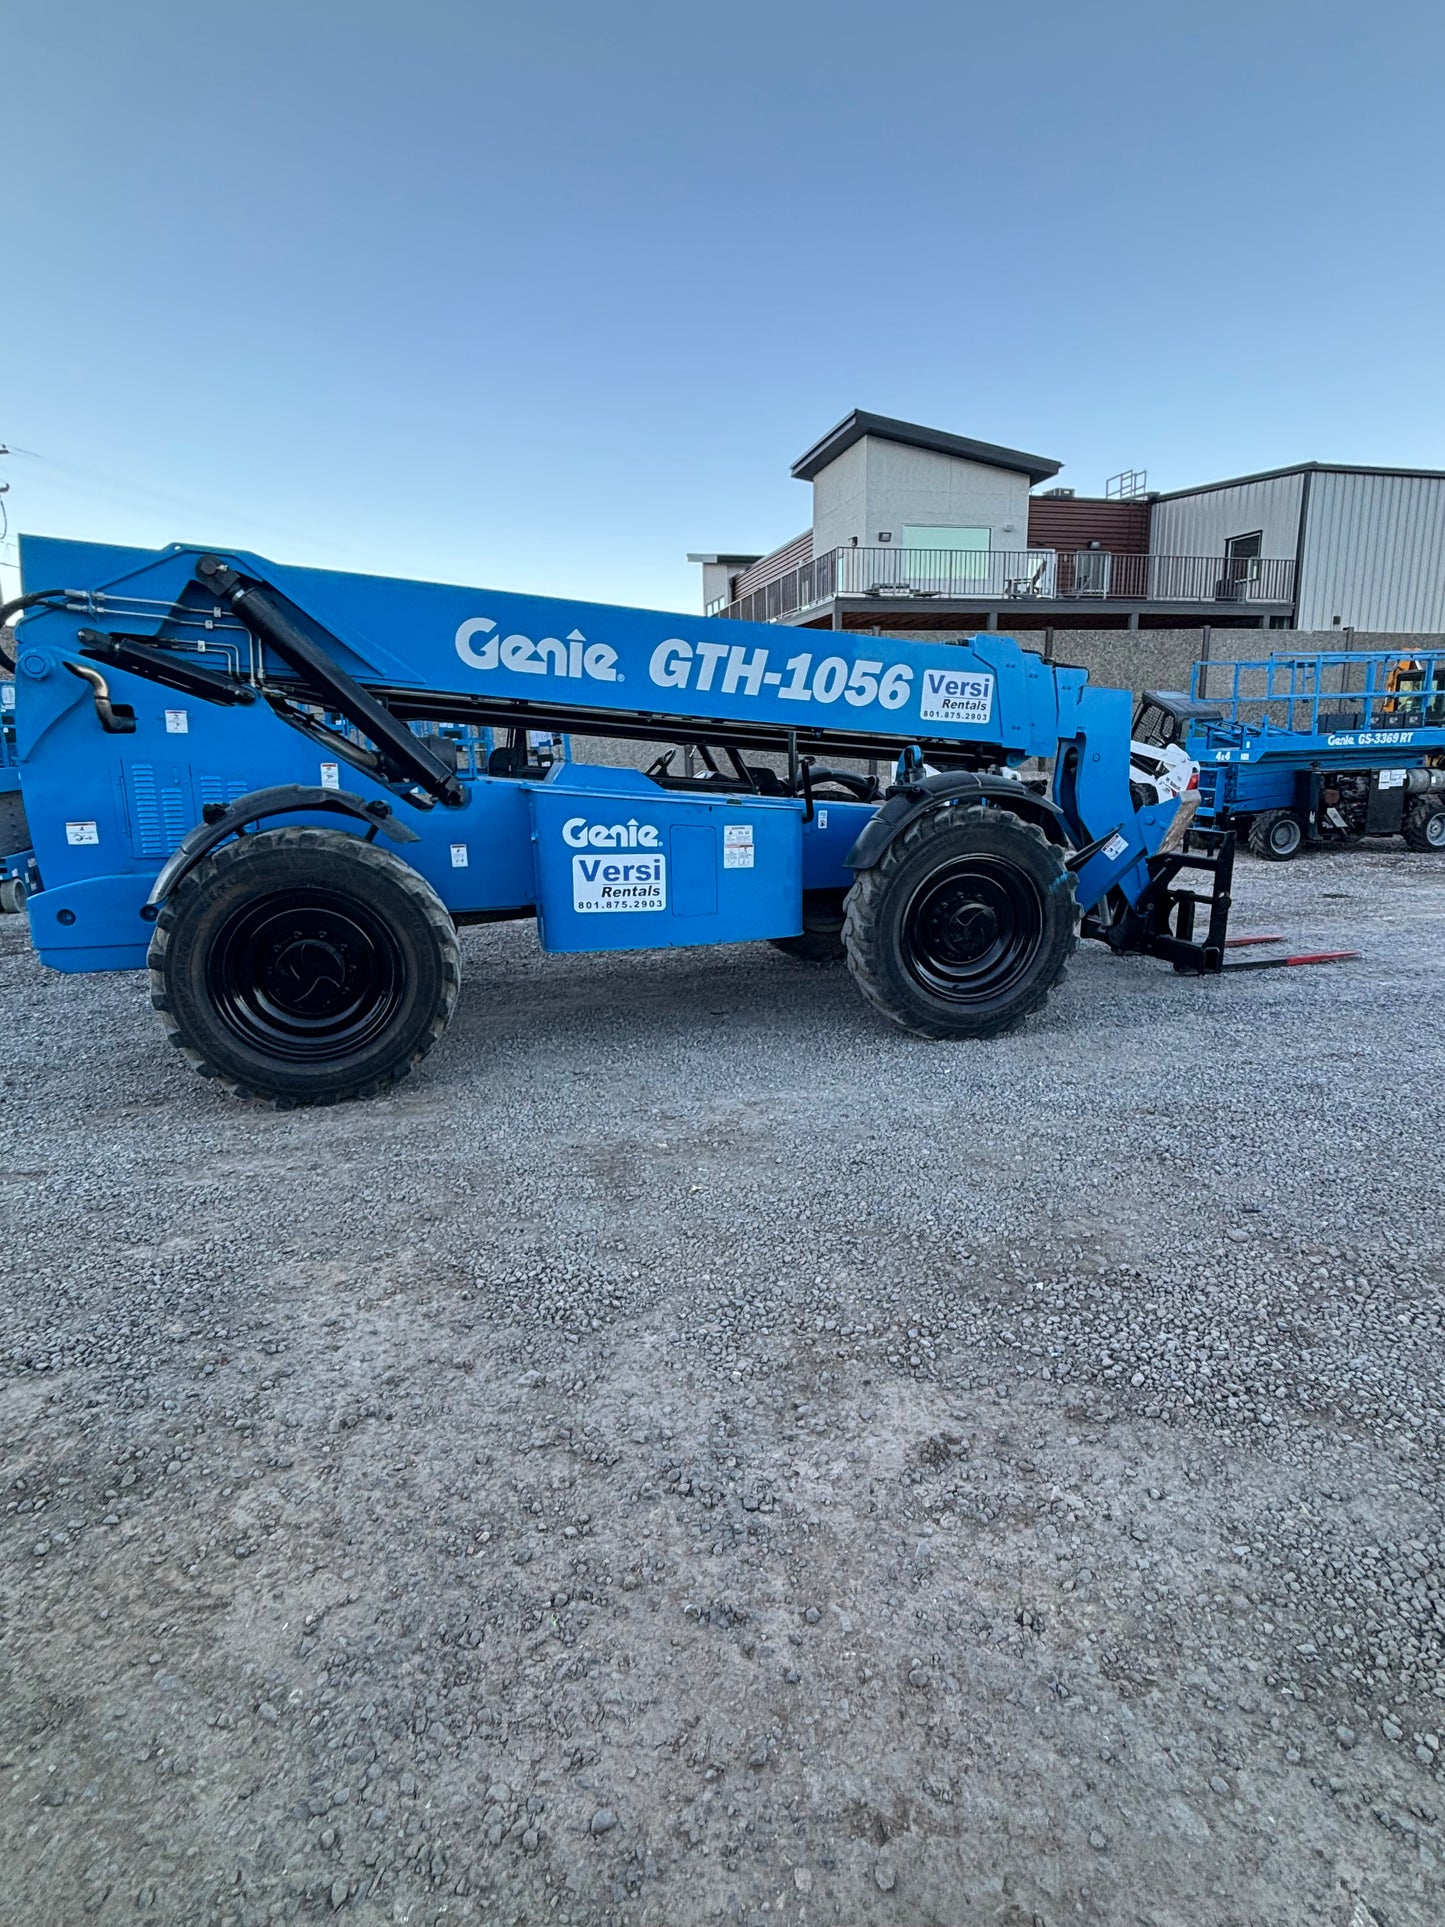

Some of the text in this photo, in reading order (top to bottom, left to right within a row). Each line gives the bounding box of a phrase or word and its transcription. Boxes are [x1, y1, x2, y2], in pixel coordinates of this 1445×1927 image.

[454, 616, 915, 710] Genie GTH-1056
[928, 673, 990, 698] Versi
[942, 698, 987, 711] Rentals
[923, 710, 988, 721] 801.875.2903
[1327, 731, 1414, 746] Genie GS-3369 RT
[562, 817, 659, 848] Genie
[578, 858, 661, 882] Versi
[601, 885, 661, 898] Rentals
[578, 900, 663, 910] 801.875.2903
